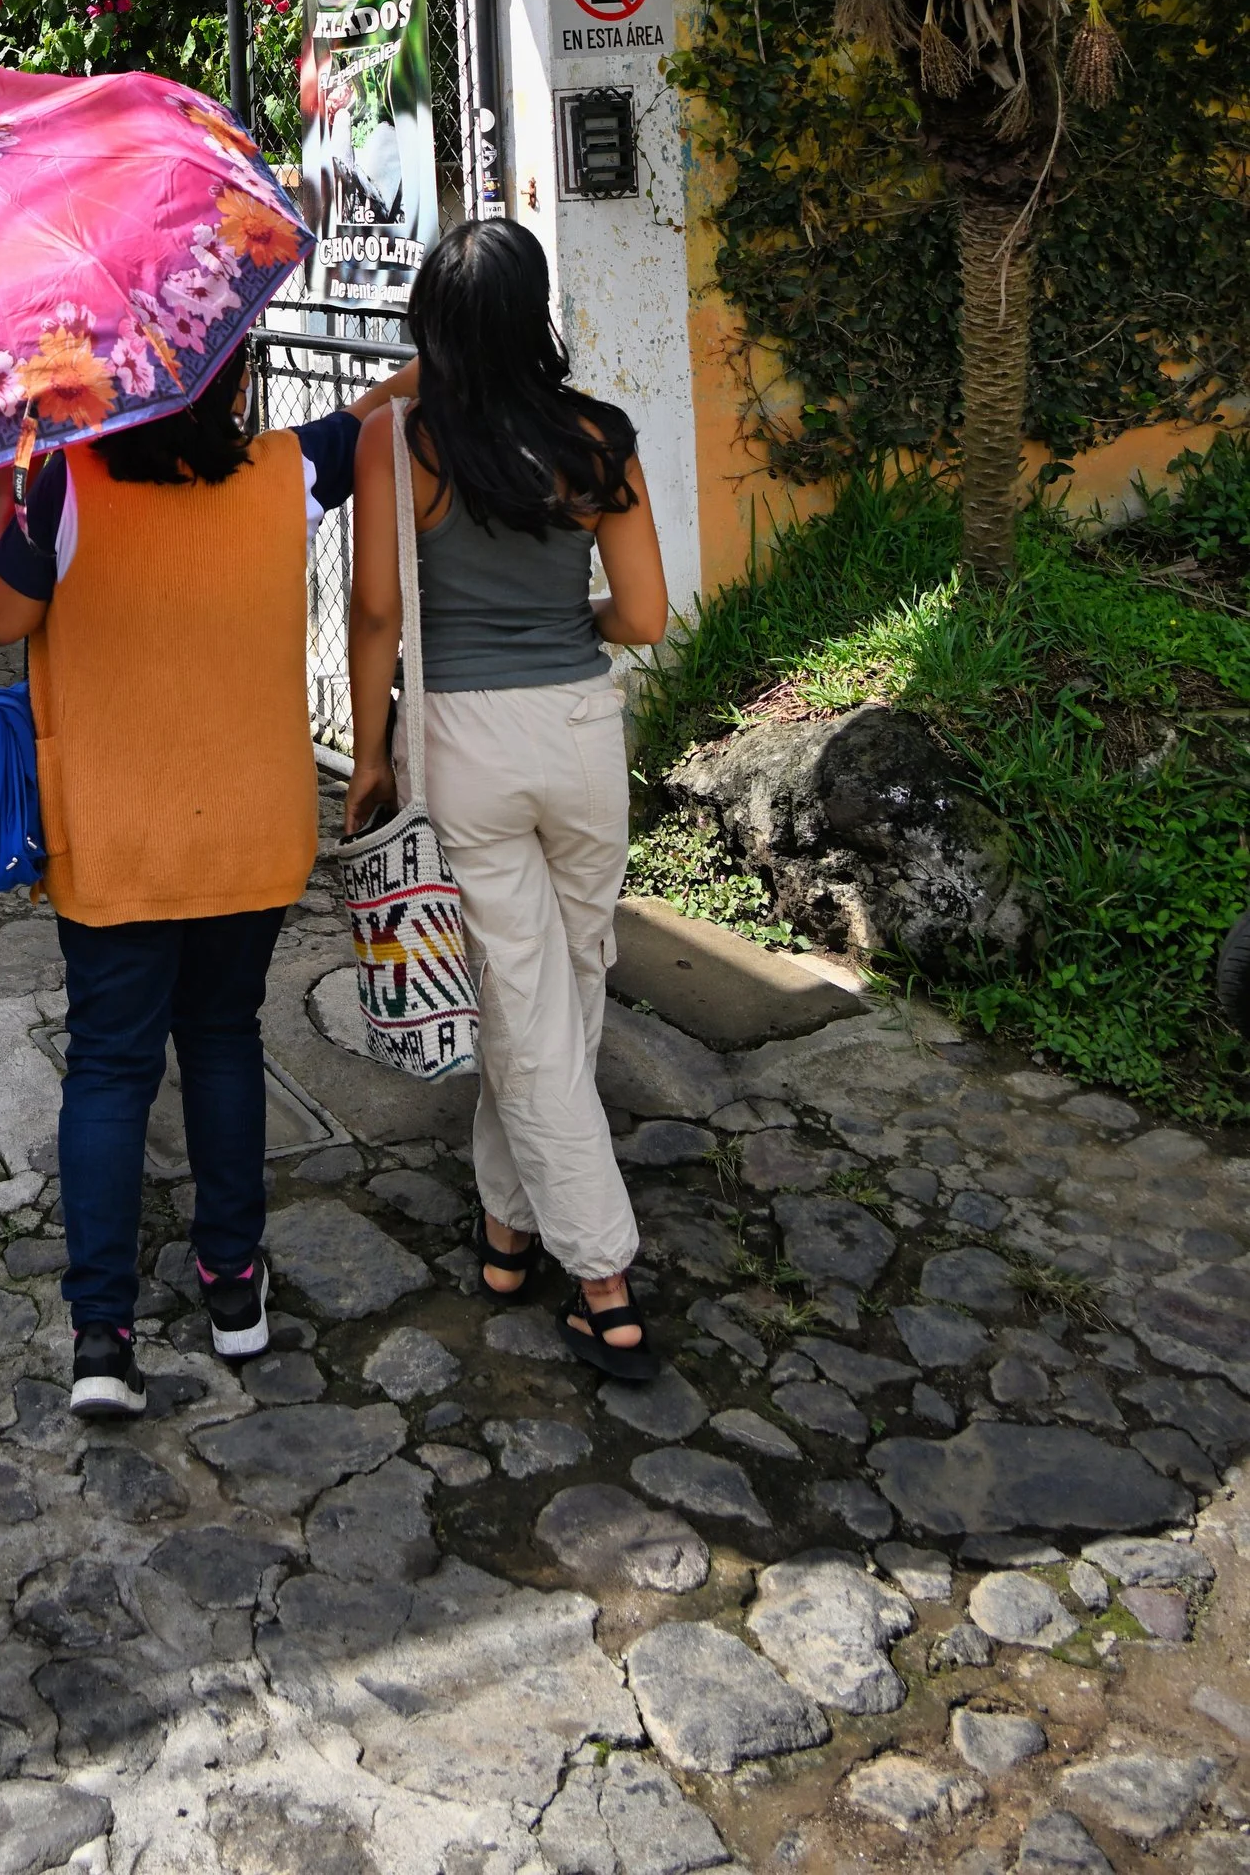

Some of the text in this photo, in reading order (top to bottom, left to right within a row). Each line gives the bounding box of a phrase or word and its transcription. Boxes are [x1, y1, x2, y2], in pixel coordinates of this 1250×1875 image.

[563, 21, 664, 51] EN ESTA ÁREA
[354, 205, 375, 223] de
[319, 236, 425, 270] CHOCOLATE
[330, 279, 346, 298] De
[347, 282, 378, 300] venta
